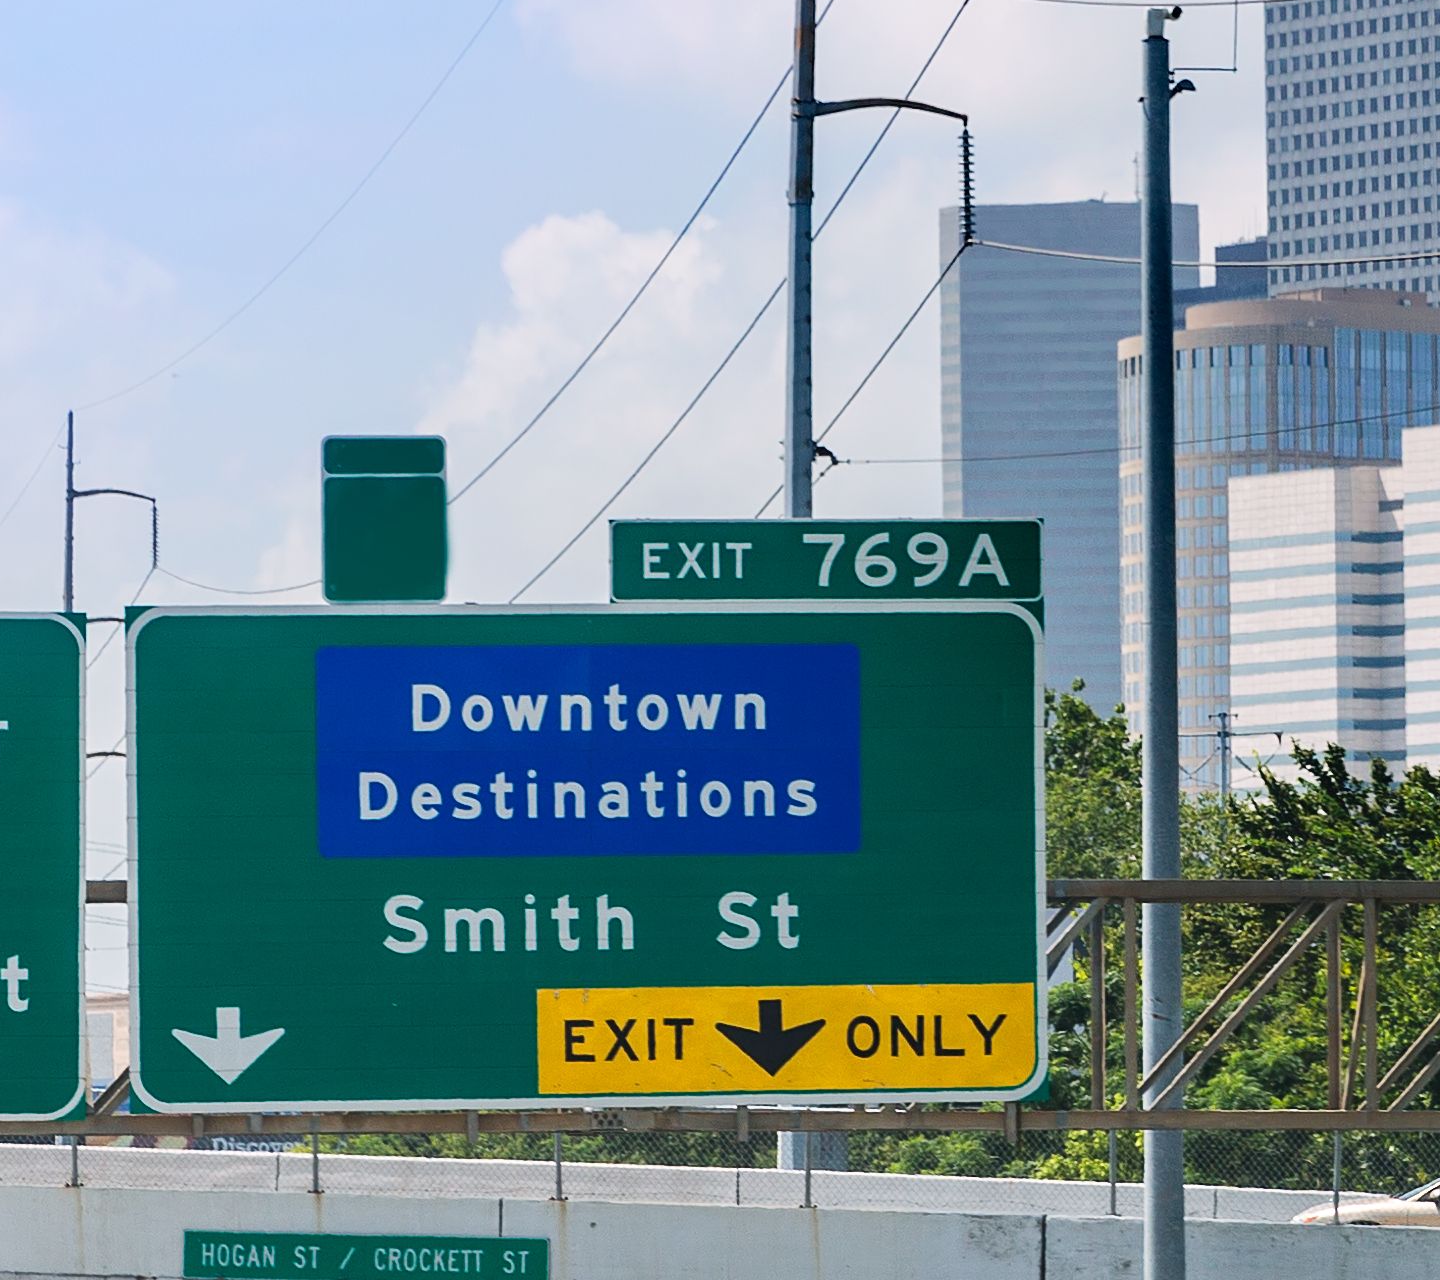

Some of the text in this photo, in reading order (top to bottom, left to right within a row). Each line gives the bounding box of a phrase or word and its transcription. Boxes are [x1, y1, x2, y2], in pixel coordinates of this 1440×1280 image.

[644, 532, 1008, 586] EXIT 769A
[413, 684, 765, 731] Downtown
[359, 771, 816, 819] Destinations
[384, 892, 798, 953] Smith St
[565, 1014, 1006, 1062] EXIT ONLY
[202, 1243, 529, 1274] HOGAN ST / CROCKETT ST
